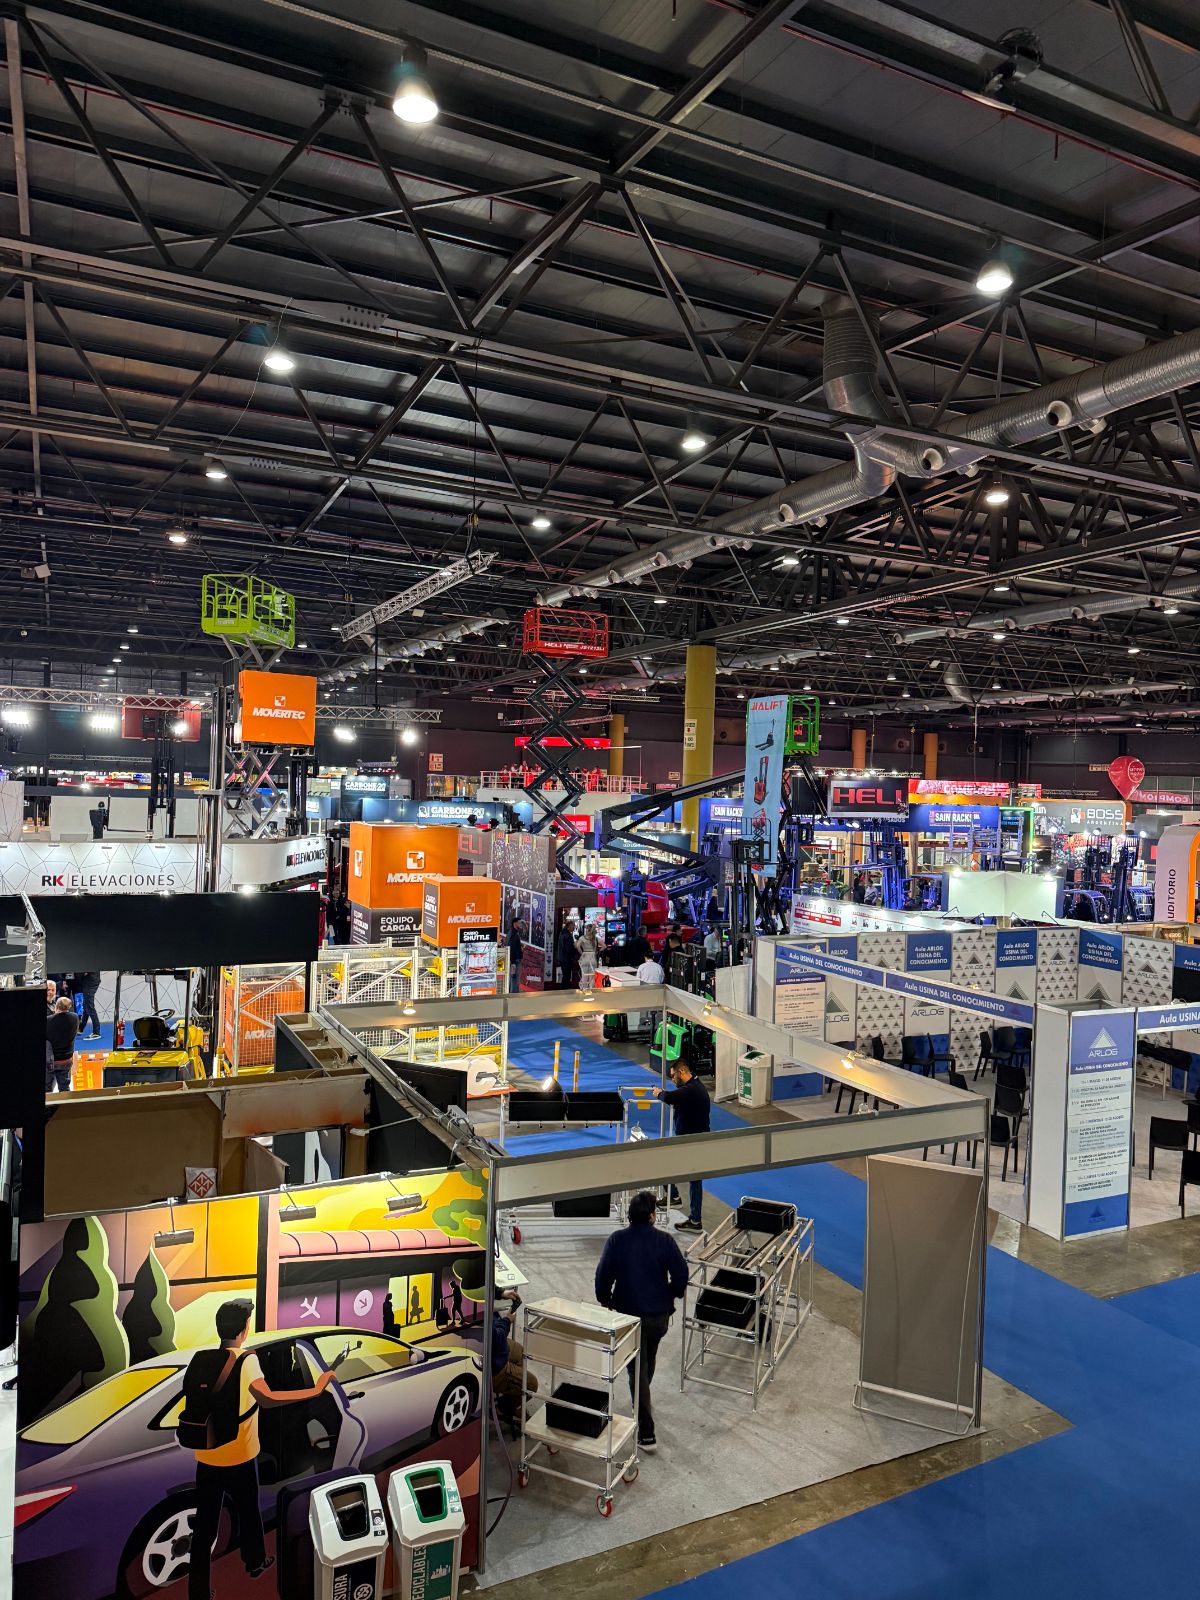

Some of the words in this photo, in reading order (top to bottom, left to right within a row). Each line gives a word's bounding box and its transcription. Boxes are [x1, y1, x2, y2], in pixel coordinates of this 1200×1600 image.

[252, 706, 306, 720] MOVERTEC
[833, 788, 902, 804] HELI
[1086, 808, 1124, 820] BOSS
[41, 875, 64, 886] RK
[71, 874, 175, 887] ELEVACIONES
[387, 872, 444, 883] MOVER
[1168, 869, 1176, 921] UDITORIO
[380, 916, 414, 924] EQUIPO
[448, 914, 493, 924] MOVERTEC
[1086, 942, 1097, 950] Aula
[1098, 943, 1114, 952] ARLOG
[800, 955, 815, 965] USINA
[824, 961, 863, 977] CONOCIMIENTO
[904, 982, 918, 990] Aula
[919, 985, 938, 996] USINA
[940, 990, 951, 999] DEL
[952, 993, 1005, 1012] CONOCIMIENTO
[911, 1008, 944, 1017] ARLOG
[1160, 1013, 1177, 1024] Aula
[1088, 1048, 1118, 1058] ARLOG
[412, 1545, 426, 1600] ECICLABLES
[334, 1573, 348, 1600] SURA
